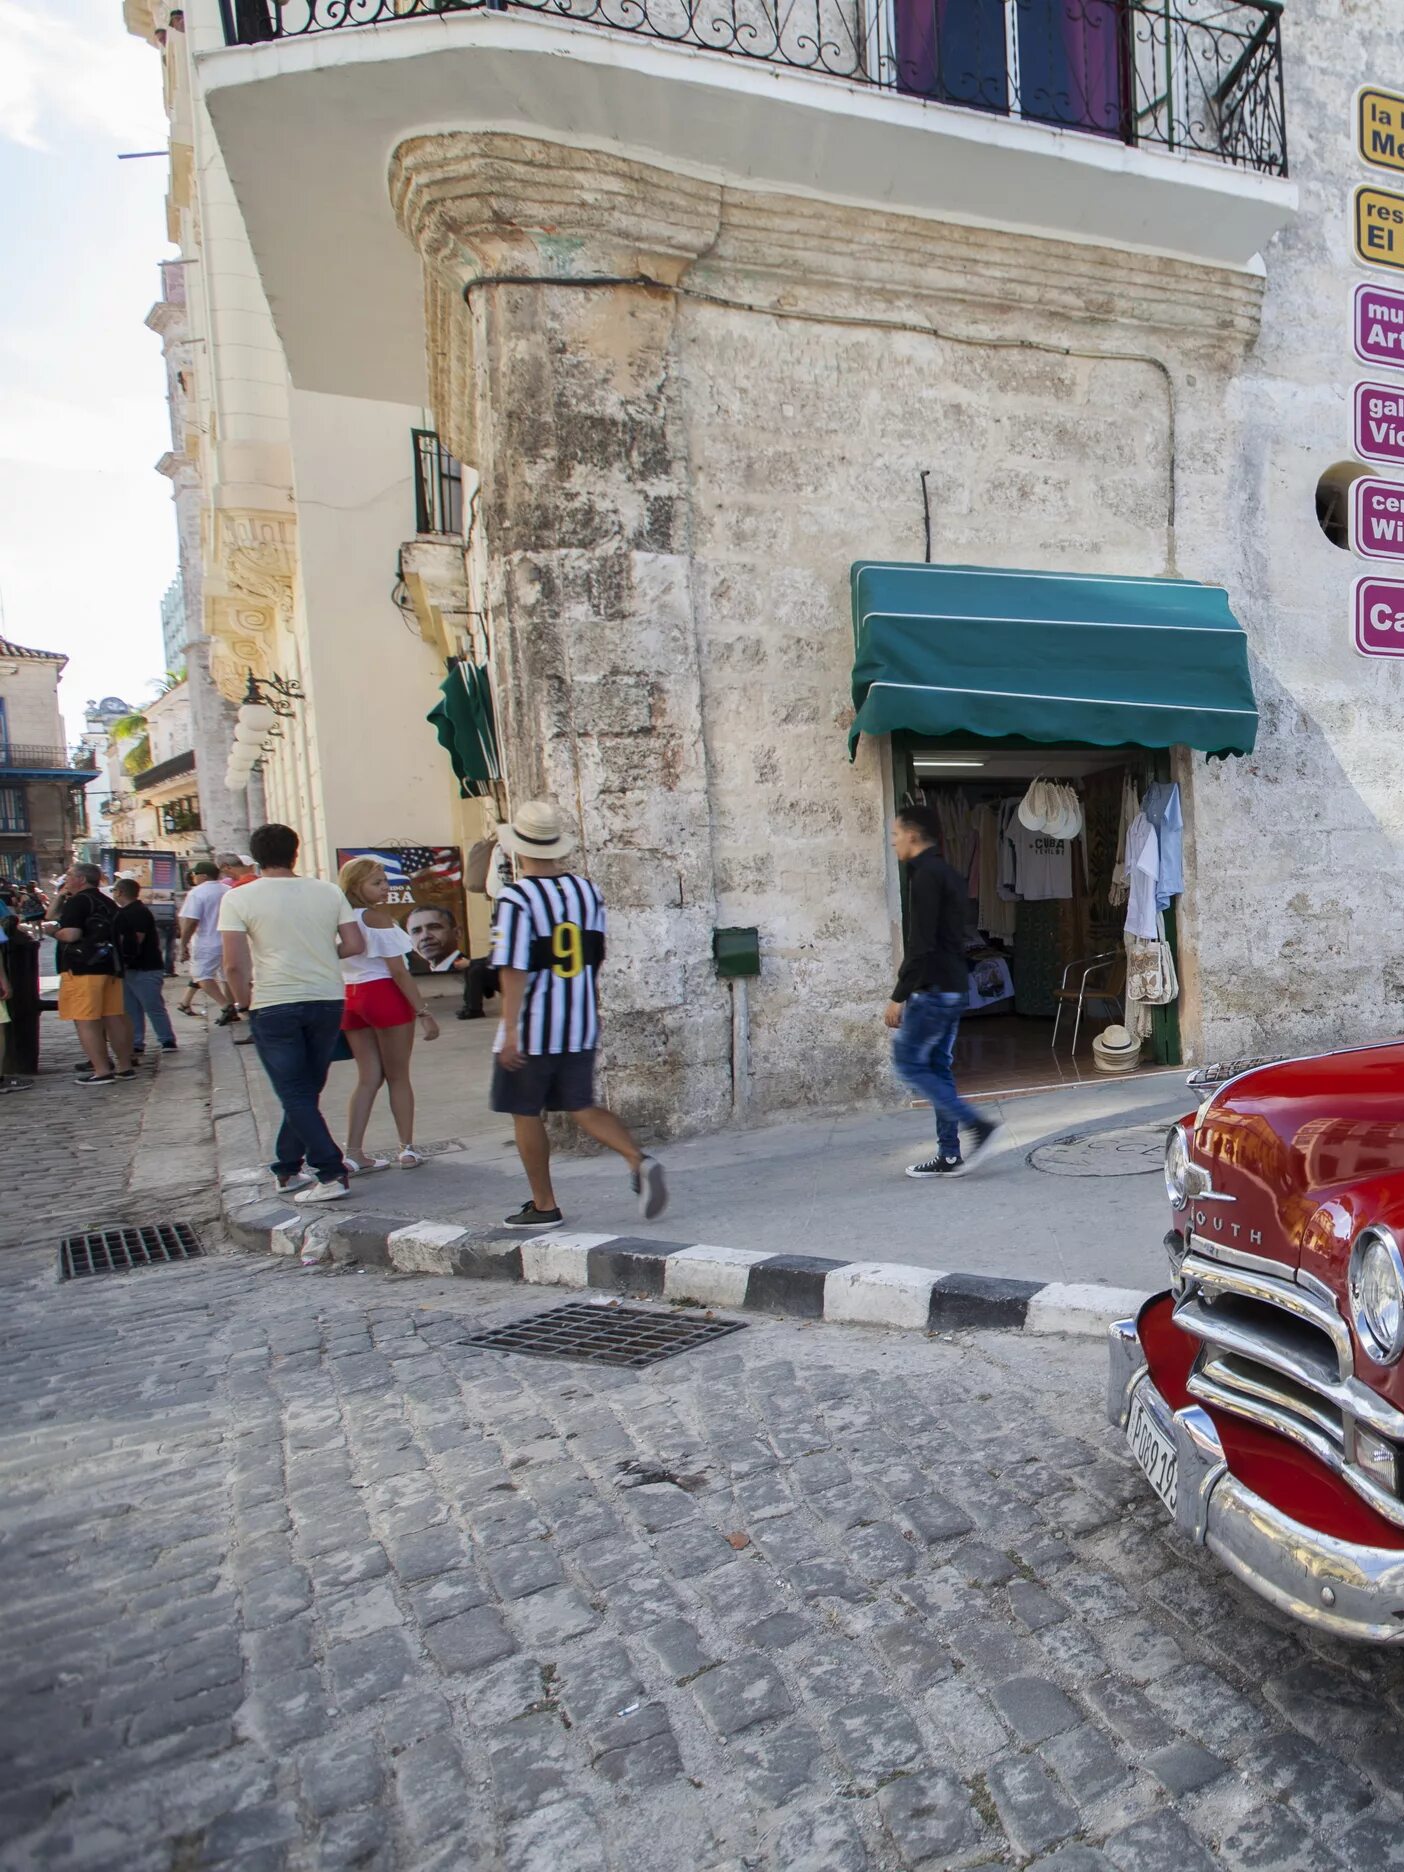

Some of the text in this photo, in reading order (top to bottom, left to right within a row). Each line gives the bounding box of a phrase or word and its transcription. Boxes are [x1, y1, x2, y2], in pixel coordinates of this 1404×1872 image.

[1371, 103, 1392, 126] la
[1367, 224, 1394, 252] El
[385, 891, 416, 905] BA
[552, 920, 582, 978] 9
[1195, 1210, 1262, 1246] OUTH
